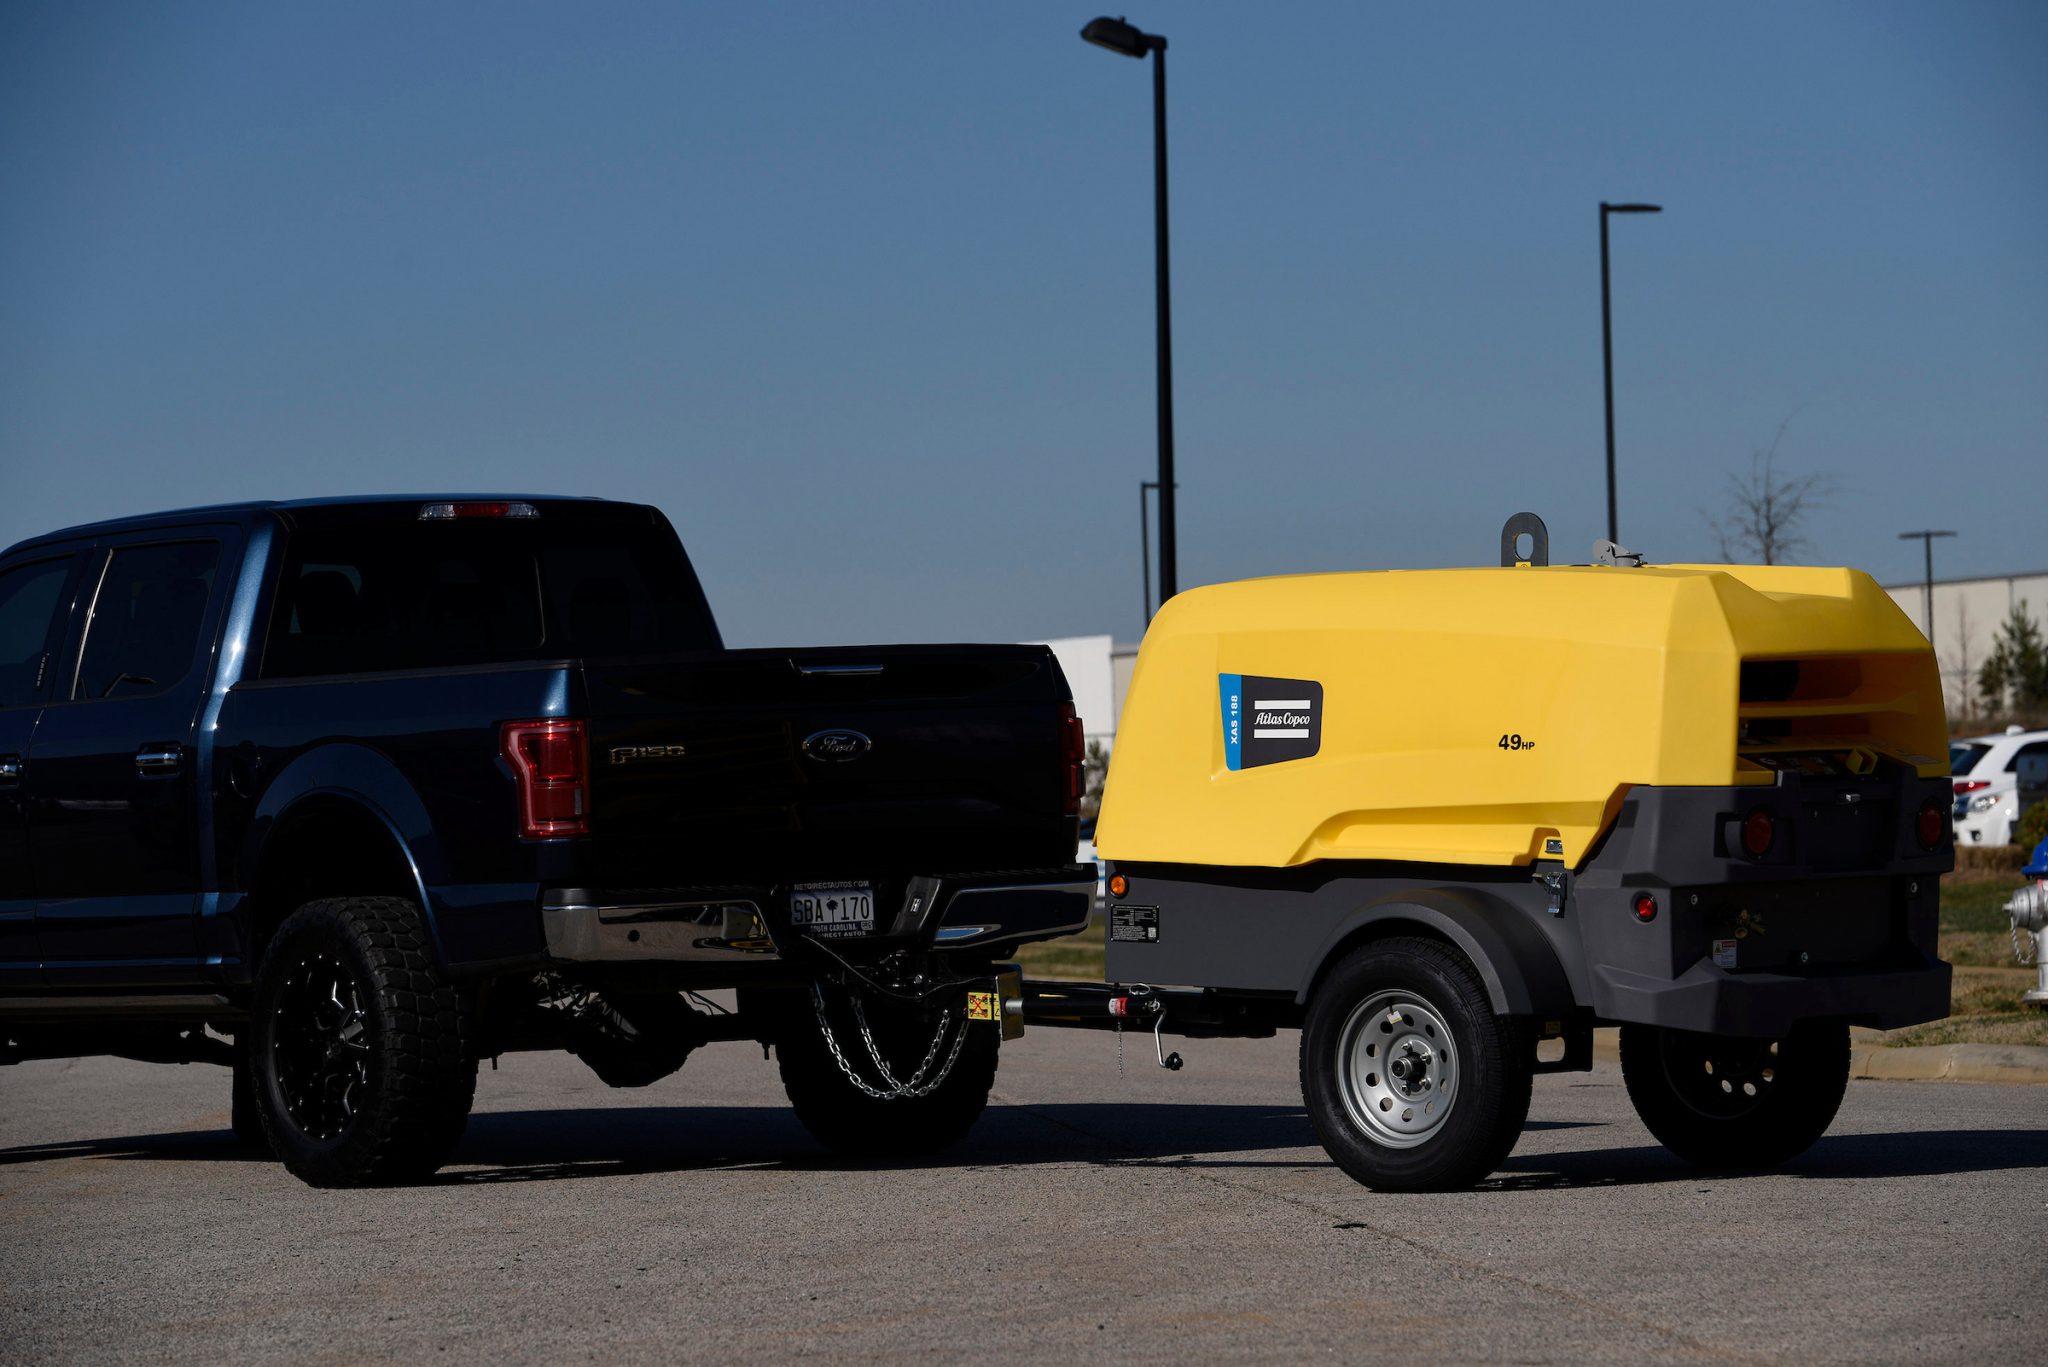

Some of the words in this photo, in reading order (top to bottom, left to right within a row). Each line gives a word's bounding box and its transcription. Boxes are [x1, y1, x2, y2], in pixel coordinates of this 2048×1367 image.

[1254, 712, 1283, 725] Atlas
[1283, 712, 1310, 727] Copco
[820, 736, 857, 752] Ford
[793, 898, 824, 923] SBA
[841, 896, 870, 921] 170
